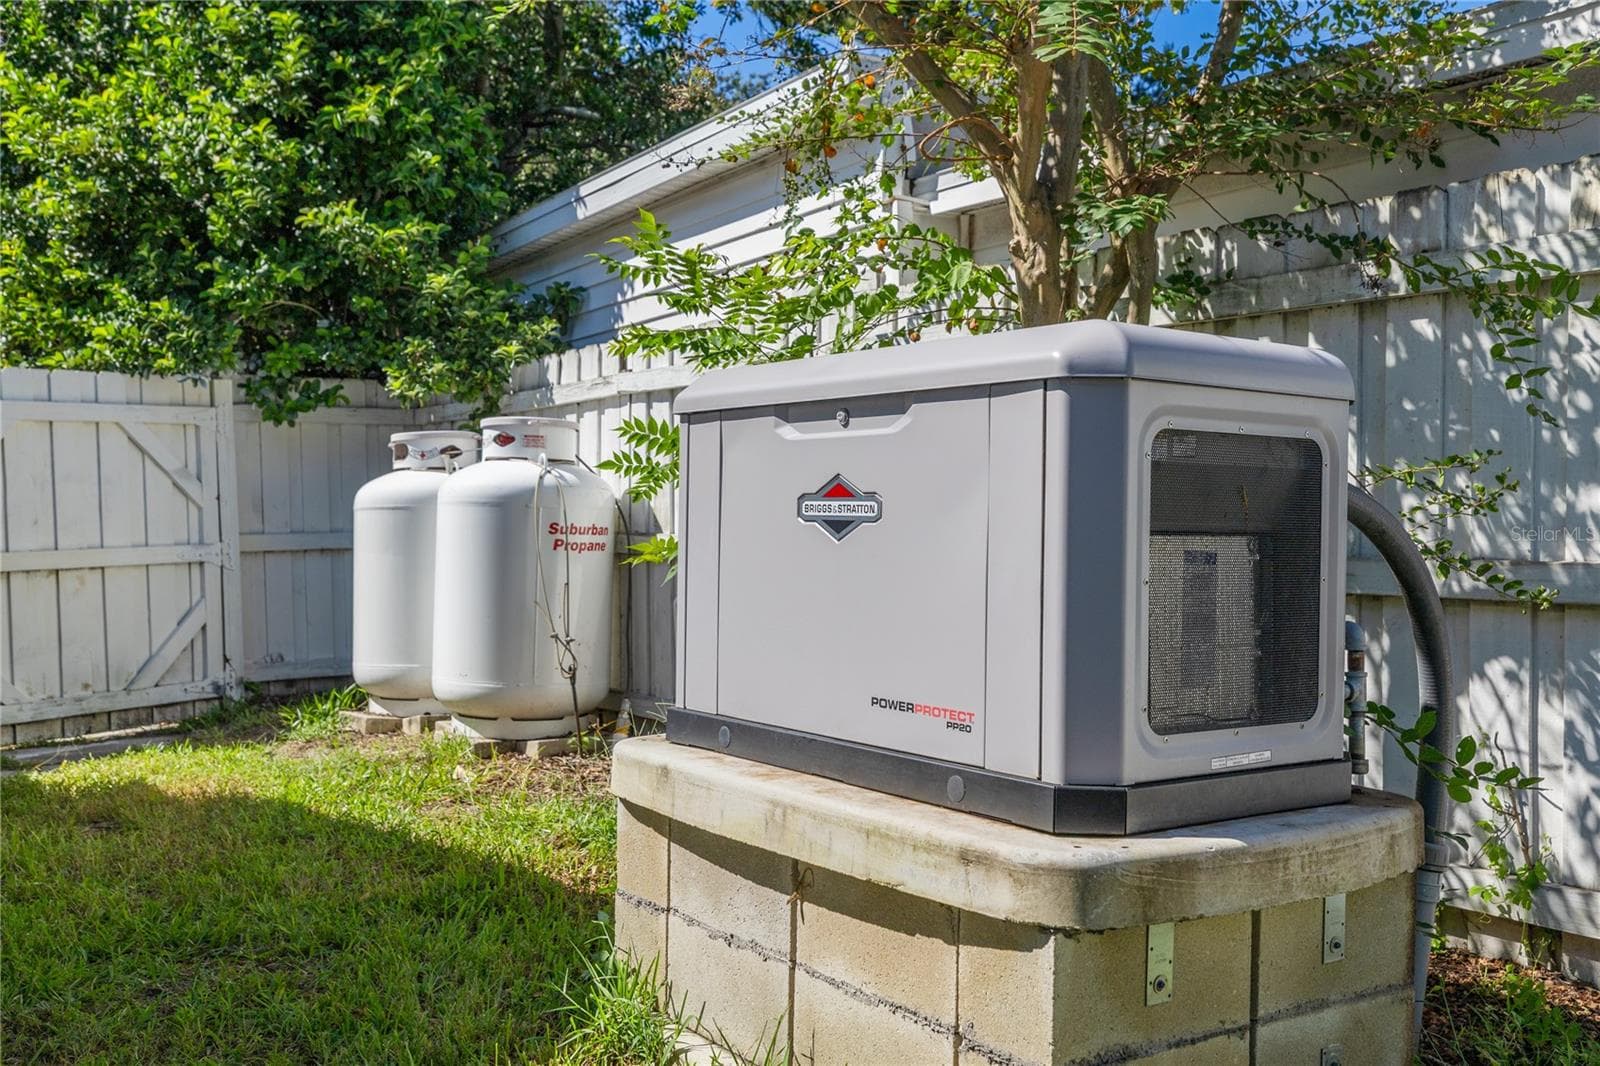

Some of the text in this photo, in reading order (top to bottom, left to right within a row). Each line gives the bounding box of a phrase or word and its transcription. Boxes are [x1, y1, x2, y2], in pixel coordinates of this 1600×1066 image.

[548, 522, 608, 536] Suburban
[553, 539, 607, 554] Propane
[946, 721, 972, 733] PP20
